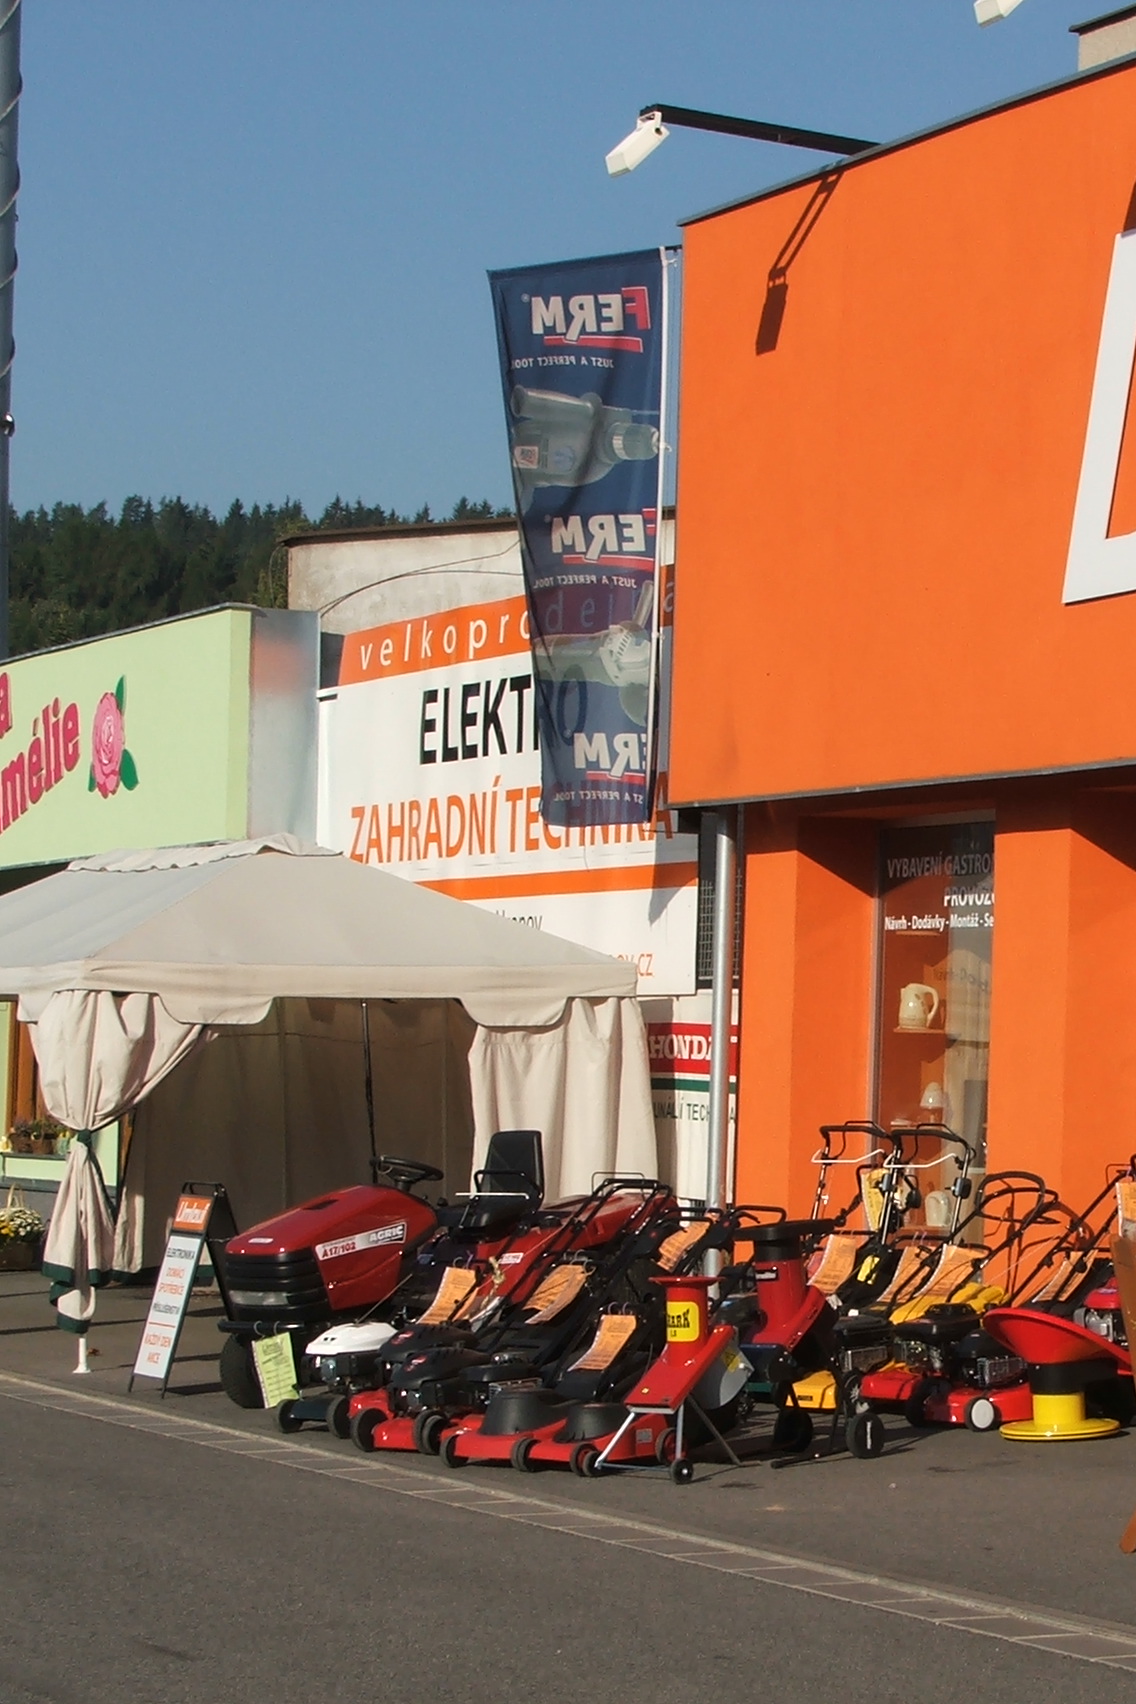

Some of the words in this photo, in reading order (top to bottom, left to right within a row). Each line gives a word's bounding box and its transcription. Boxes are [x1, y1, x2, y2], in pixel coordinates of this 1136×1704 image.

[0, 697, 80, 834] mélie
[350, 775, 501, 864] ZAHRADNÍ
[944, 853, 991, 876] GASTRO
